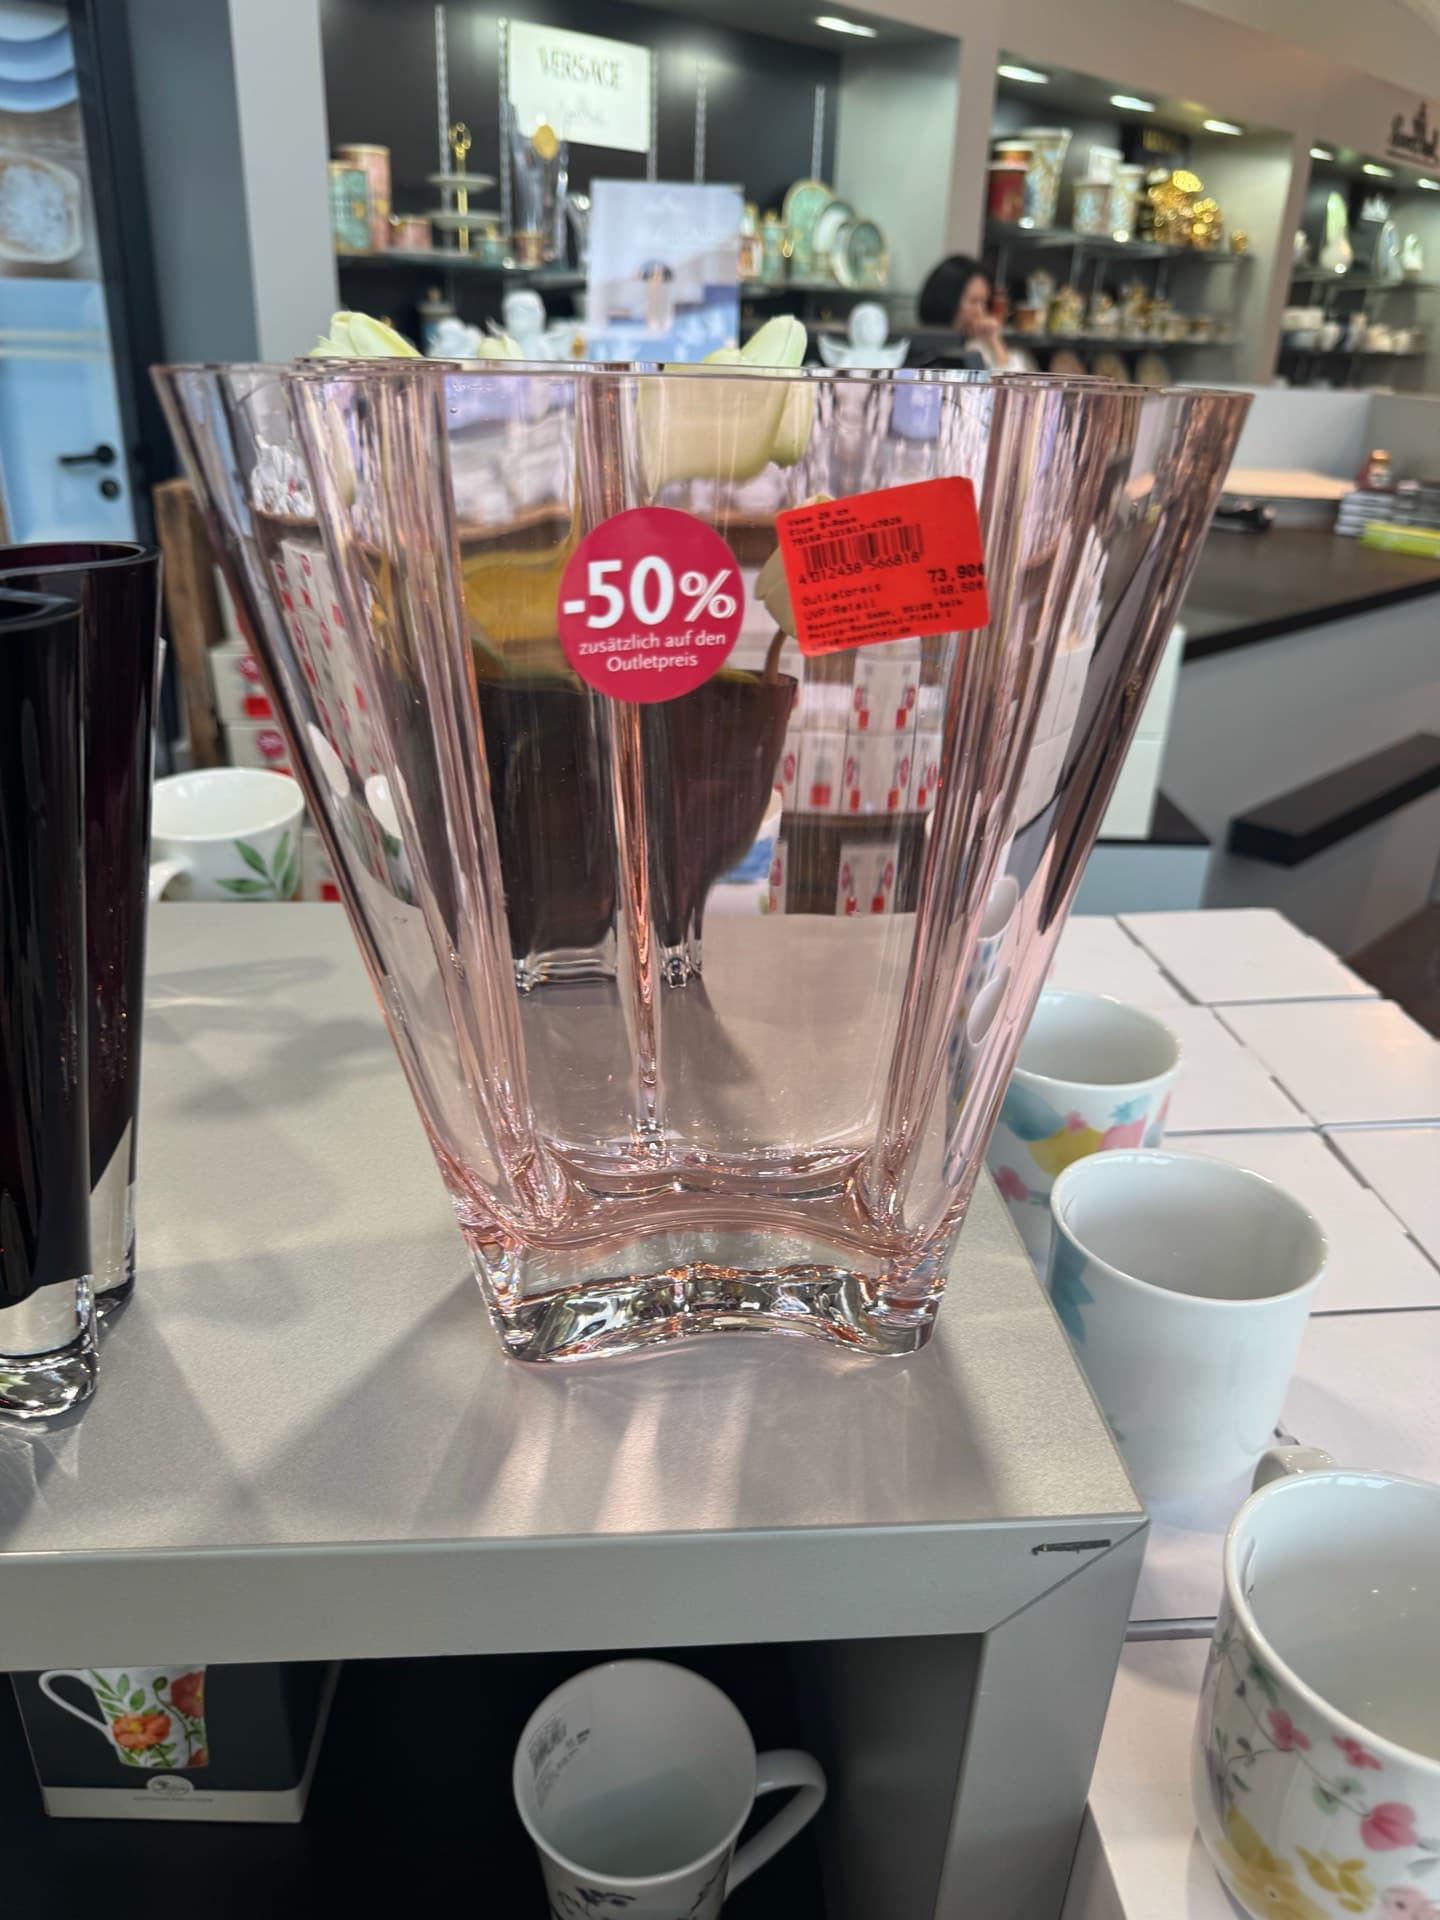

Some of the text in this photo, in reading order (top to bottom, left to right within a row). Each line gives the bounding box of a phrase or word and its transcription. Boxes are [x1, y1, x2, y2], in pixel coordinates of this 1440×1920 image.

[538, 46, 620, 91] VERSACE
[563, 555, 736, 629] -50%
[579, 630, 727, 655] zusätzlich auf den
[606, 652, 699, 673] Outletpreis
